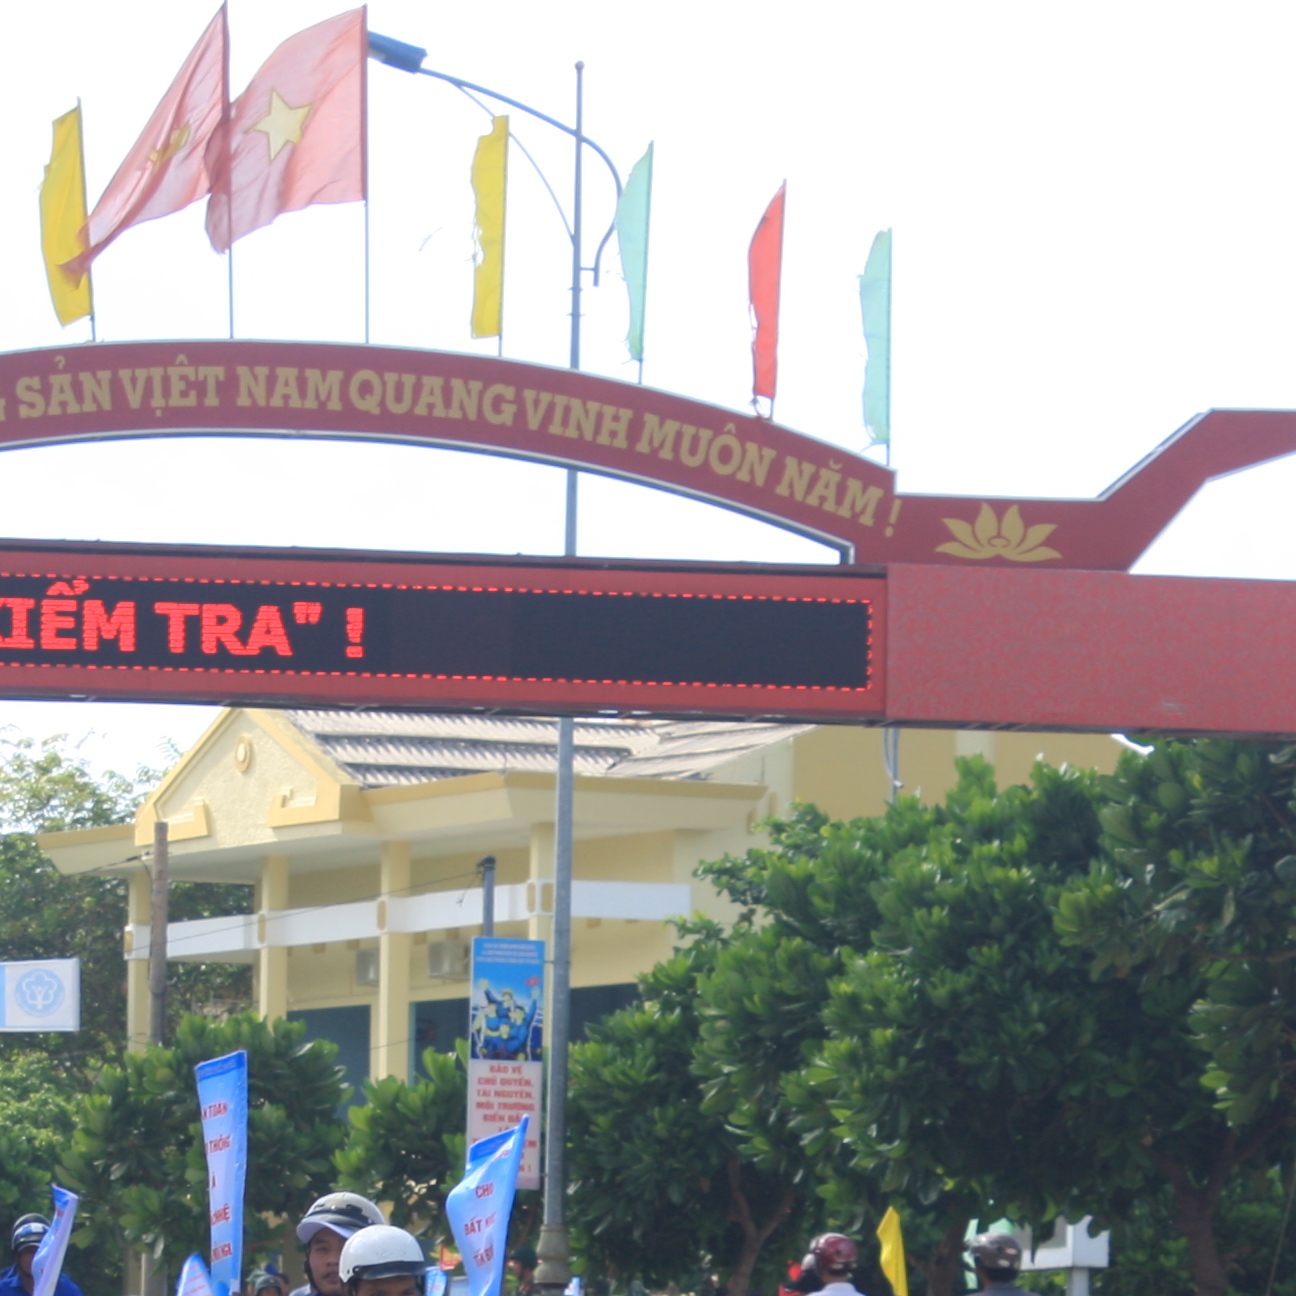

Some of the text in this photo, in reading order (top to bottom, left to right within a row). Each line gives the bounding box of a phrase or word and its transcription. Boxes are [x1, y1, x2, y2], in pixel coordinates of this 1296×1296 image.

[14, 356, 113, 419] SẢN
[118, 354, 225, 417] VIỆT
[235, 366, 343, 411] NAM
[349, 368, 518, 428] QUANG
[521, 388, 634, 451] VINH
[635, 412, 777, 487] MUÔN
[775, 455, 894, 528] NĂM
